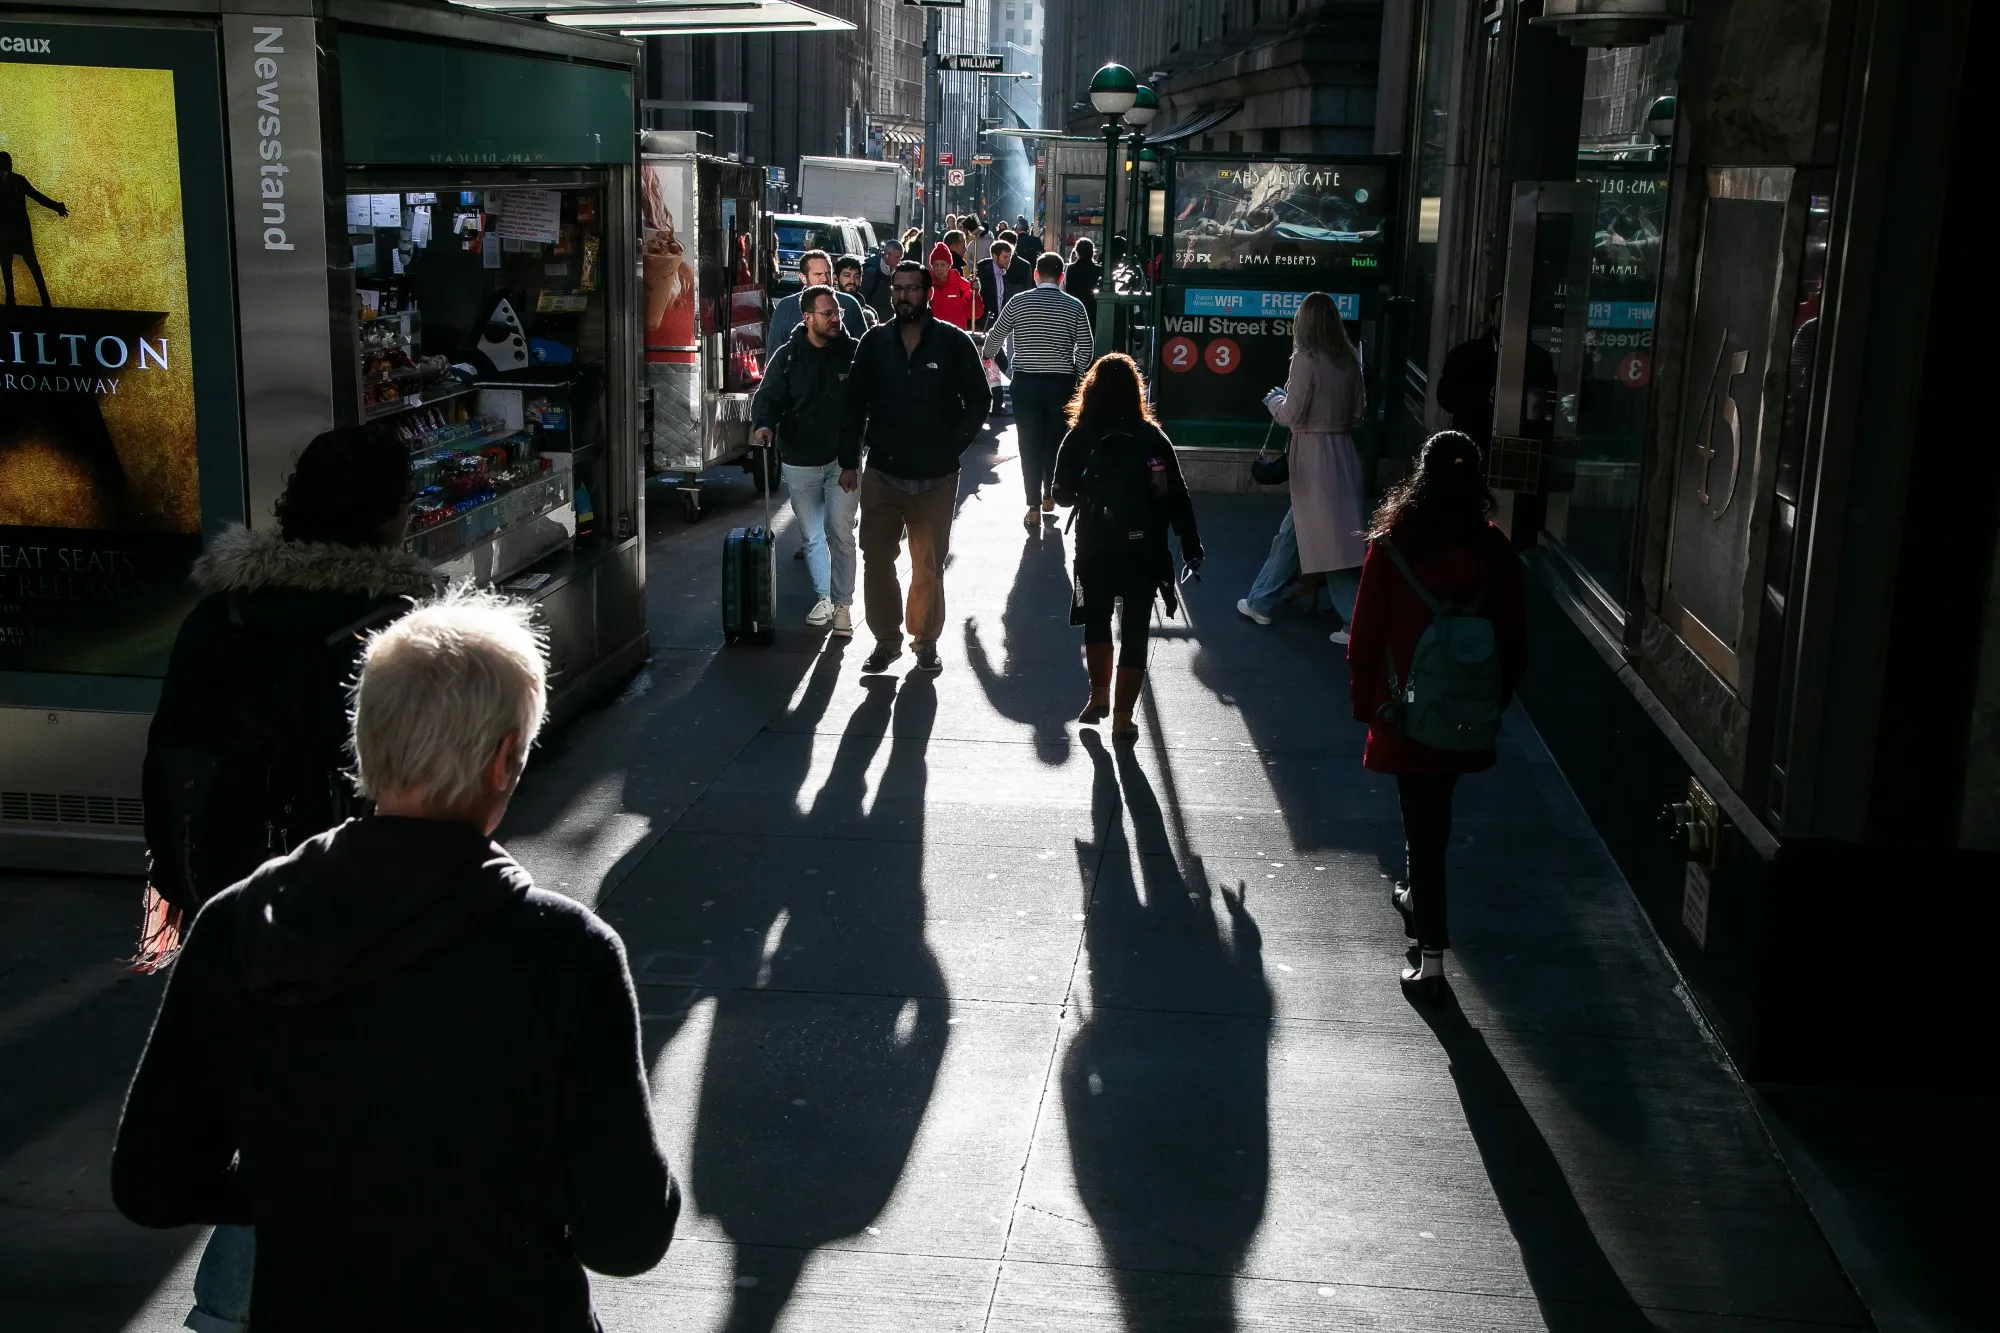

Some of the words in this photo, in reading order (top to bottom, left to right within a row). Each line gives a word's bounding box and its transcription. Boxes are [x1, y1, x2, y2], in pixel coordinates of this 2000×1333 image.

[960, 57, 996, 69] WILLIAM
[251, 26, 295, 252] Newsstand
[1047, 146, 1055, 192] Newsstand
[1269, 171, 1341, 187] DELICATE
[1196, 253, 1212, 263] FX
[1239, 254, 1270, 265] EMMA
[1351, 256, 1378, 267] hulu
[1261, 293, 1302, 309] FREE
[1164, 315, 1204, 334] Wall
[1208, 317, 1268, 336] Street
[0, 331, 171, 372] ILTON
[1172, 344, 1188, 366] 2
[1215, 344, 1230, 366] 3
[0, 373, 120, 396] ROADWAY
[58, 547, 134, 575] SEATS
